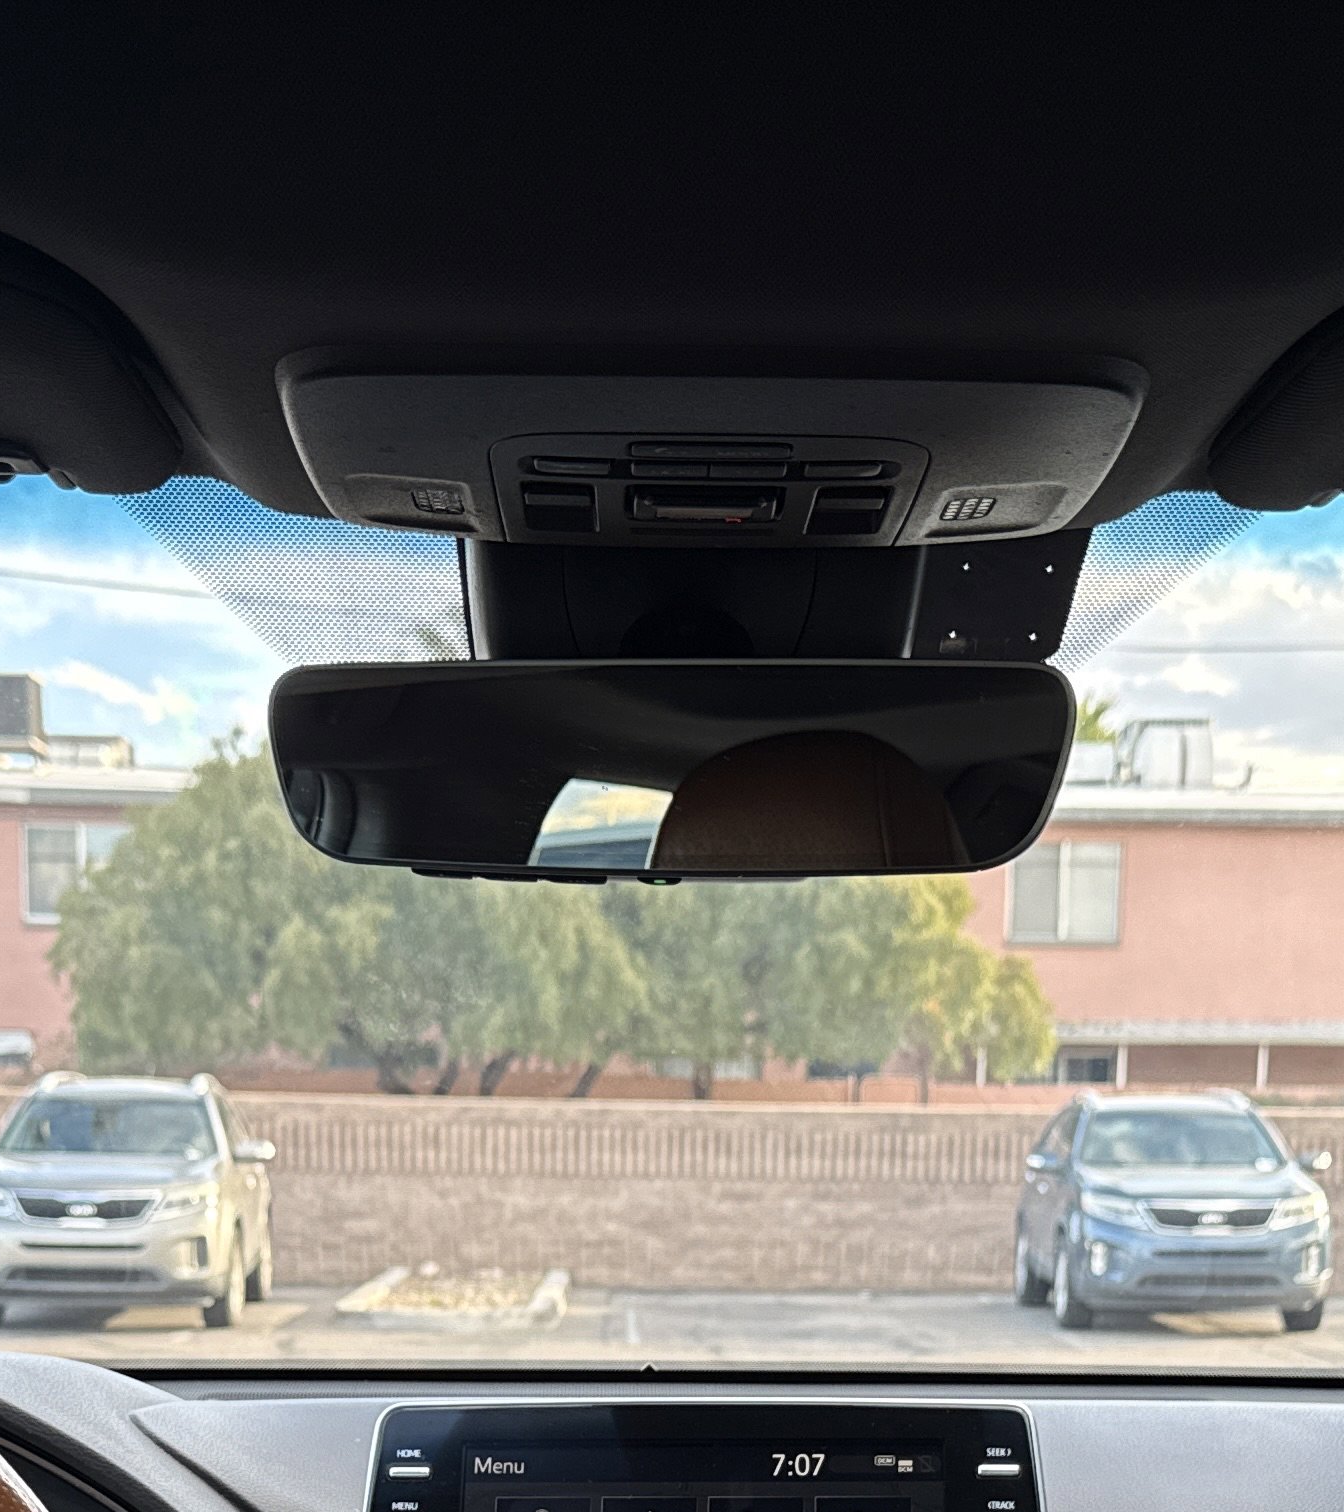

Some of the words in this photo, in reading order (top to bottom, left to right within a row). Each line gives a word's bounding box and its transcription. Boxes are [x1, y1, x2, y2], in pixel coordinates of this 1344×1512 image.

[396, 1449, 422, 1458] HOME
[474, 1457, 525, 1475] Menu
[771, 1453, 826, 1477] 7:07
[392, 1502, 419, 1511] MENU
